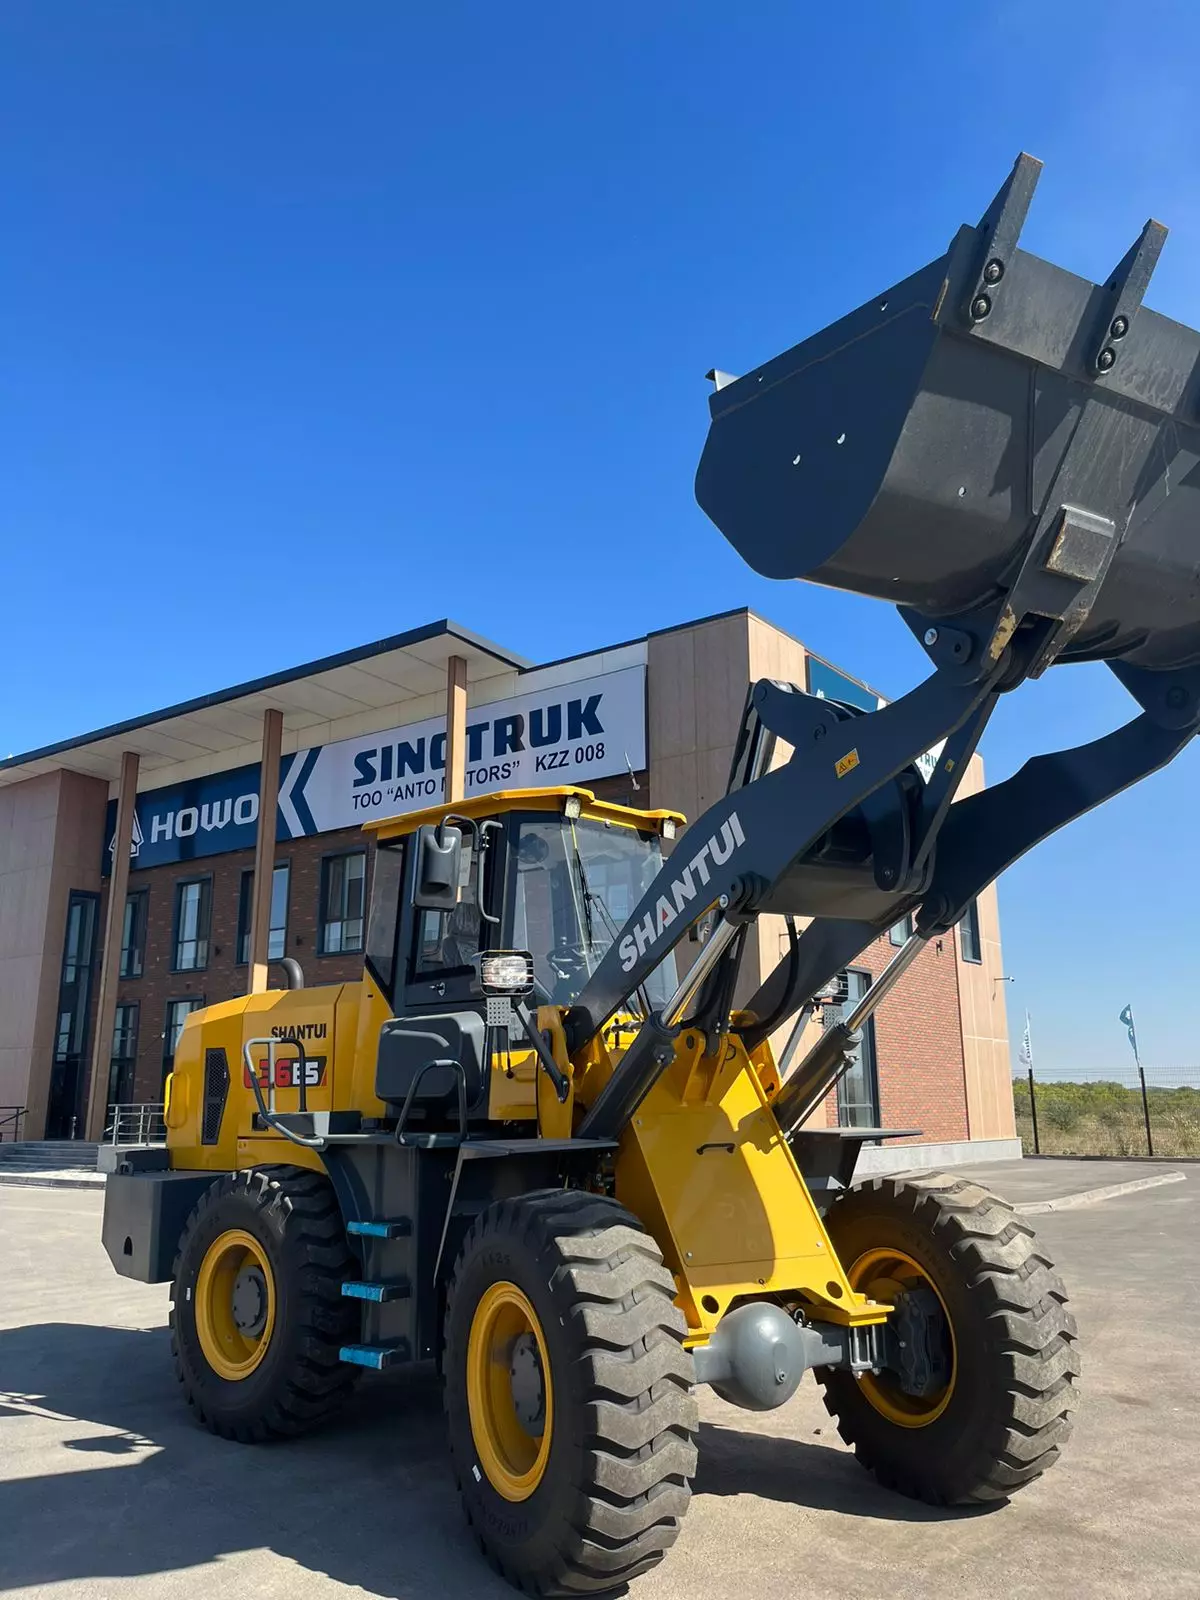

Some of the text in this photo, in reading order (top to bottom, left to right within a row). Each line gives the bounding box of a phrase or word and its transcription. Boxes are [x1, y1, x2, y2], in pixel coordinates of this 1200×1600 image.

[352, 790, 382, 810] TOO
[535, 750, 570, 773] KZZ
[575, 742, 605, 765] 008
[150, 793, 260, 844] HOWO
[618, 811, 746, 973] SHANTUI
[271, 1023, 327, 1040] SHANTUI
